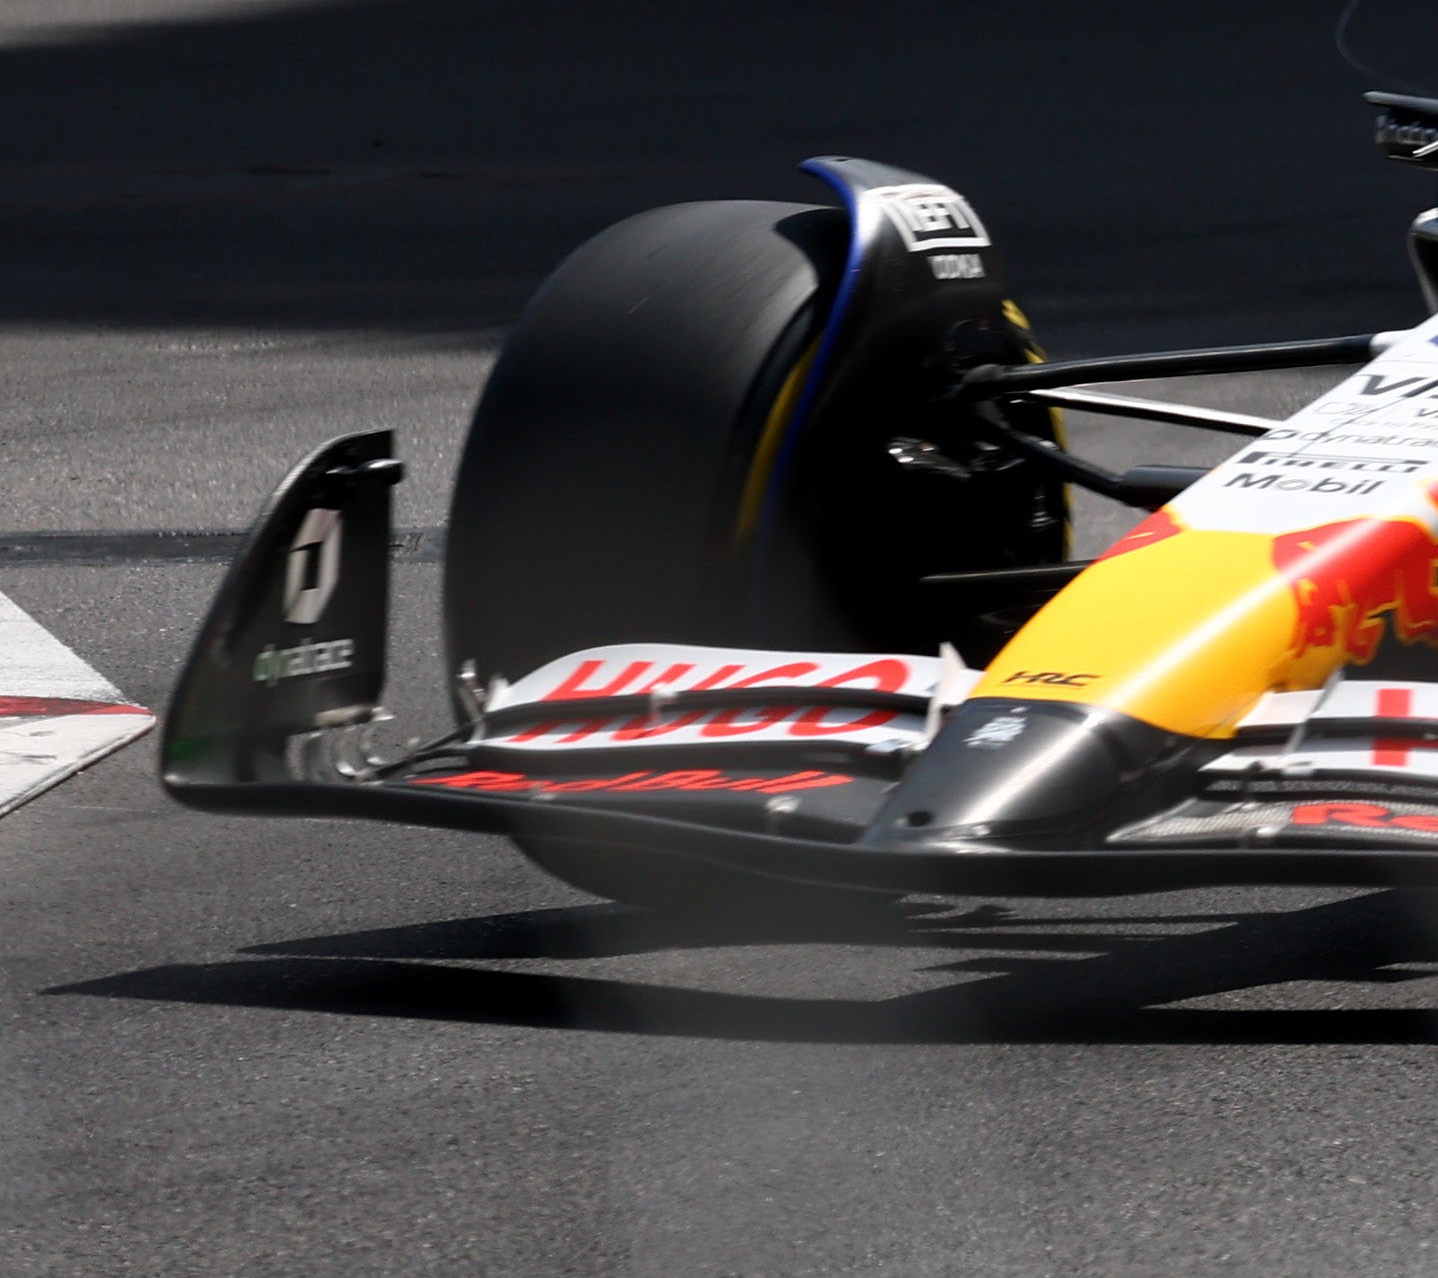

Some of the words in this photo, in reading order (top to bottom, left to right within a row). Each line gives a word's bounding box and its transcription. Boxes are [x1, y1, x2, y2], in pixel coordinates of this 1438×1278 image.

[1234, 451, 1433, 474] PIRELLI
[1222, 471, 1387, 495] Mobil
[1003, 670, 1104, 688] HRC
[507, 658, 912, 744] HUGO
